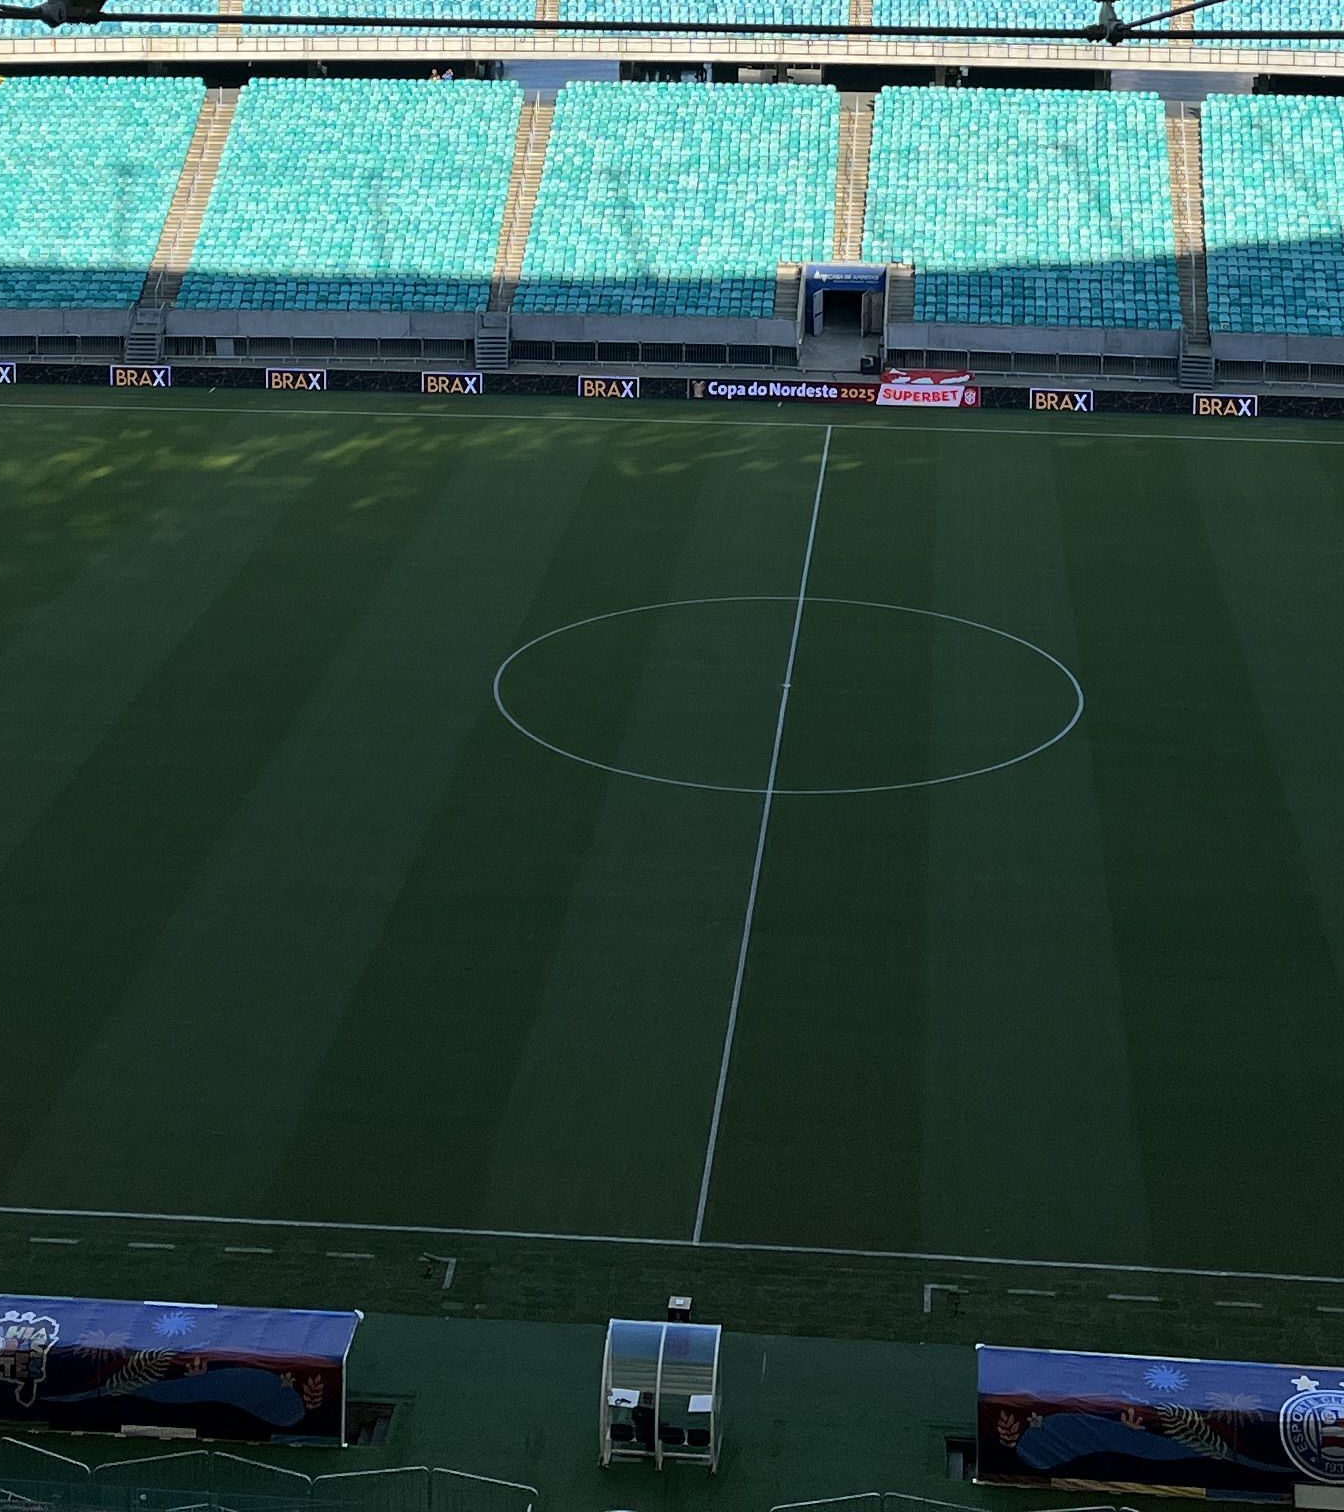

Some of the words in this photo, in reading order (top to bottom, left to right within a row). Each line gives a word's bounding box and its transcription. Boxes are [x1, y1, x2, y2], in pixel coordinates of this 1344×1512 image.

[115, 367, 166, 387] BRAX
[270, 370, 322, 390] BRAX
[426, 375, 478, 394] BRAX
[583, 378, 635, 399] BRAX
[708, 381, 746, 400] Copa
[748, 381, 767, 397] do
[769, 382, 838, 399] Nordeste
[840, 387, 876, 403] 2025
[882, 388, 959, 403] SUPERBET
[1035, 391, 1088, 412] BRAX
[1196, 397, 1254, 418] BRAX
